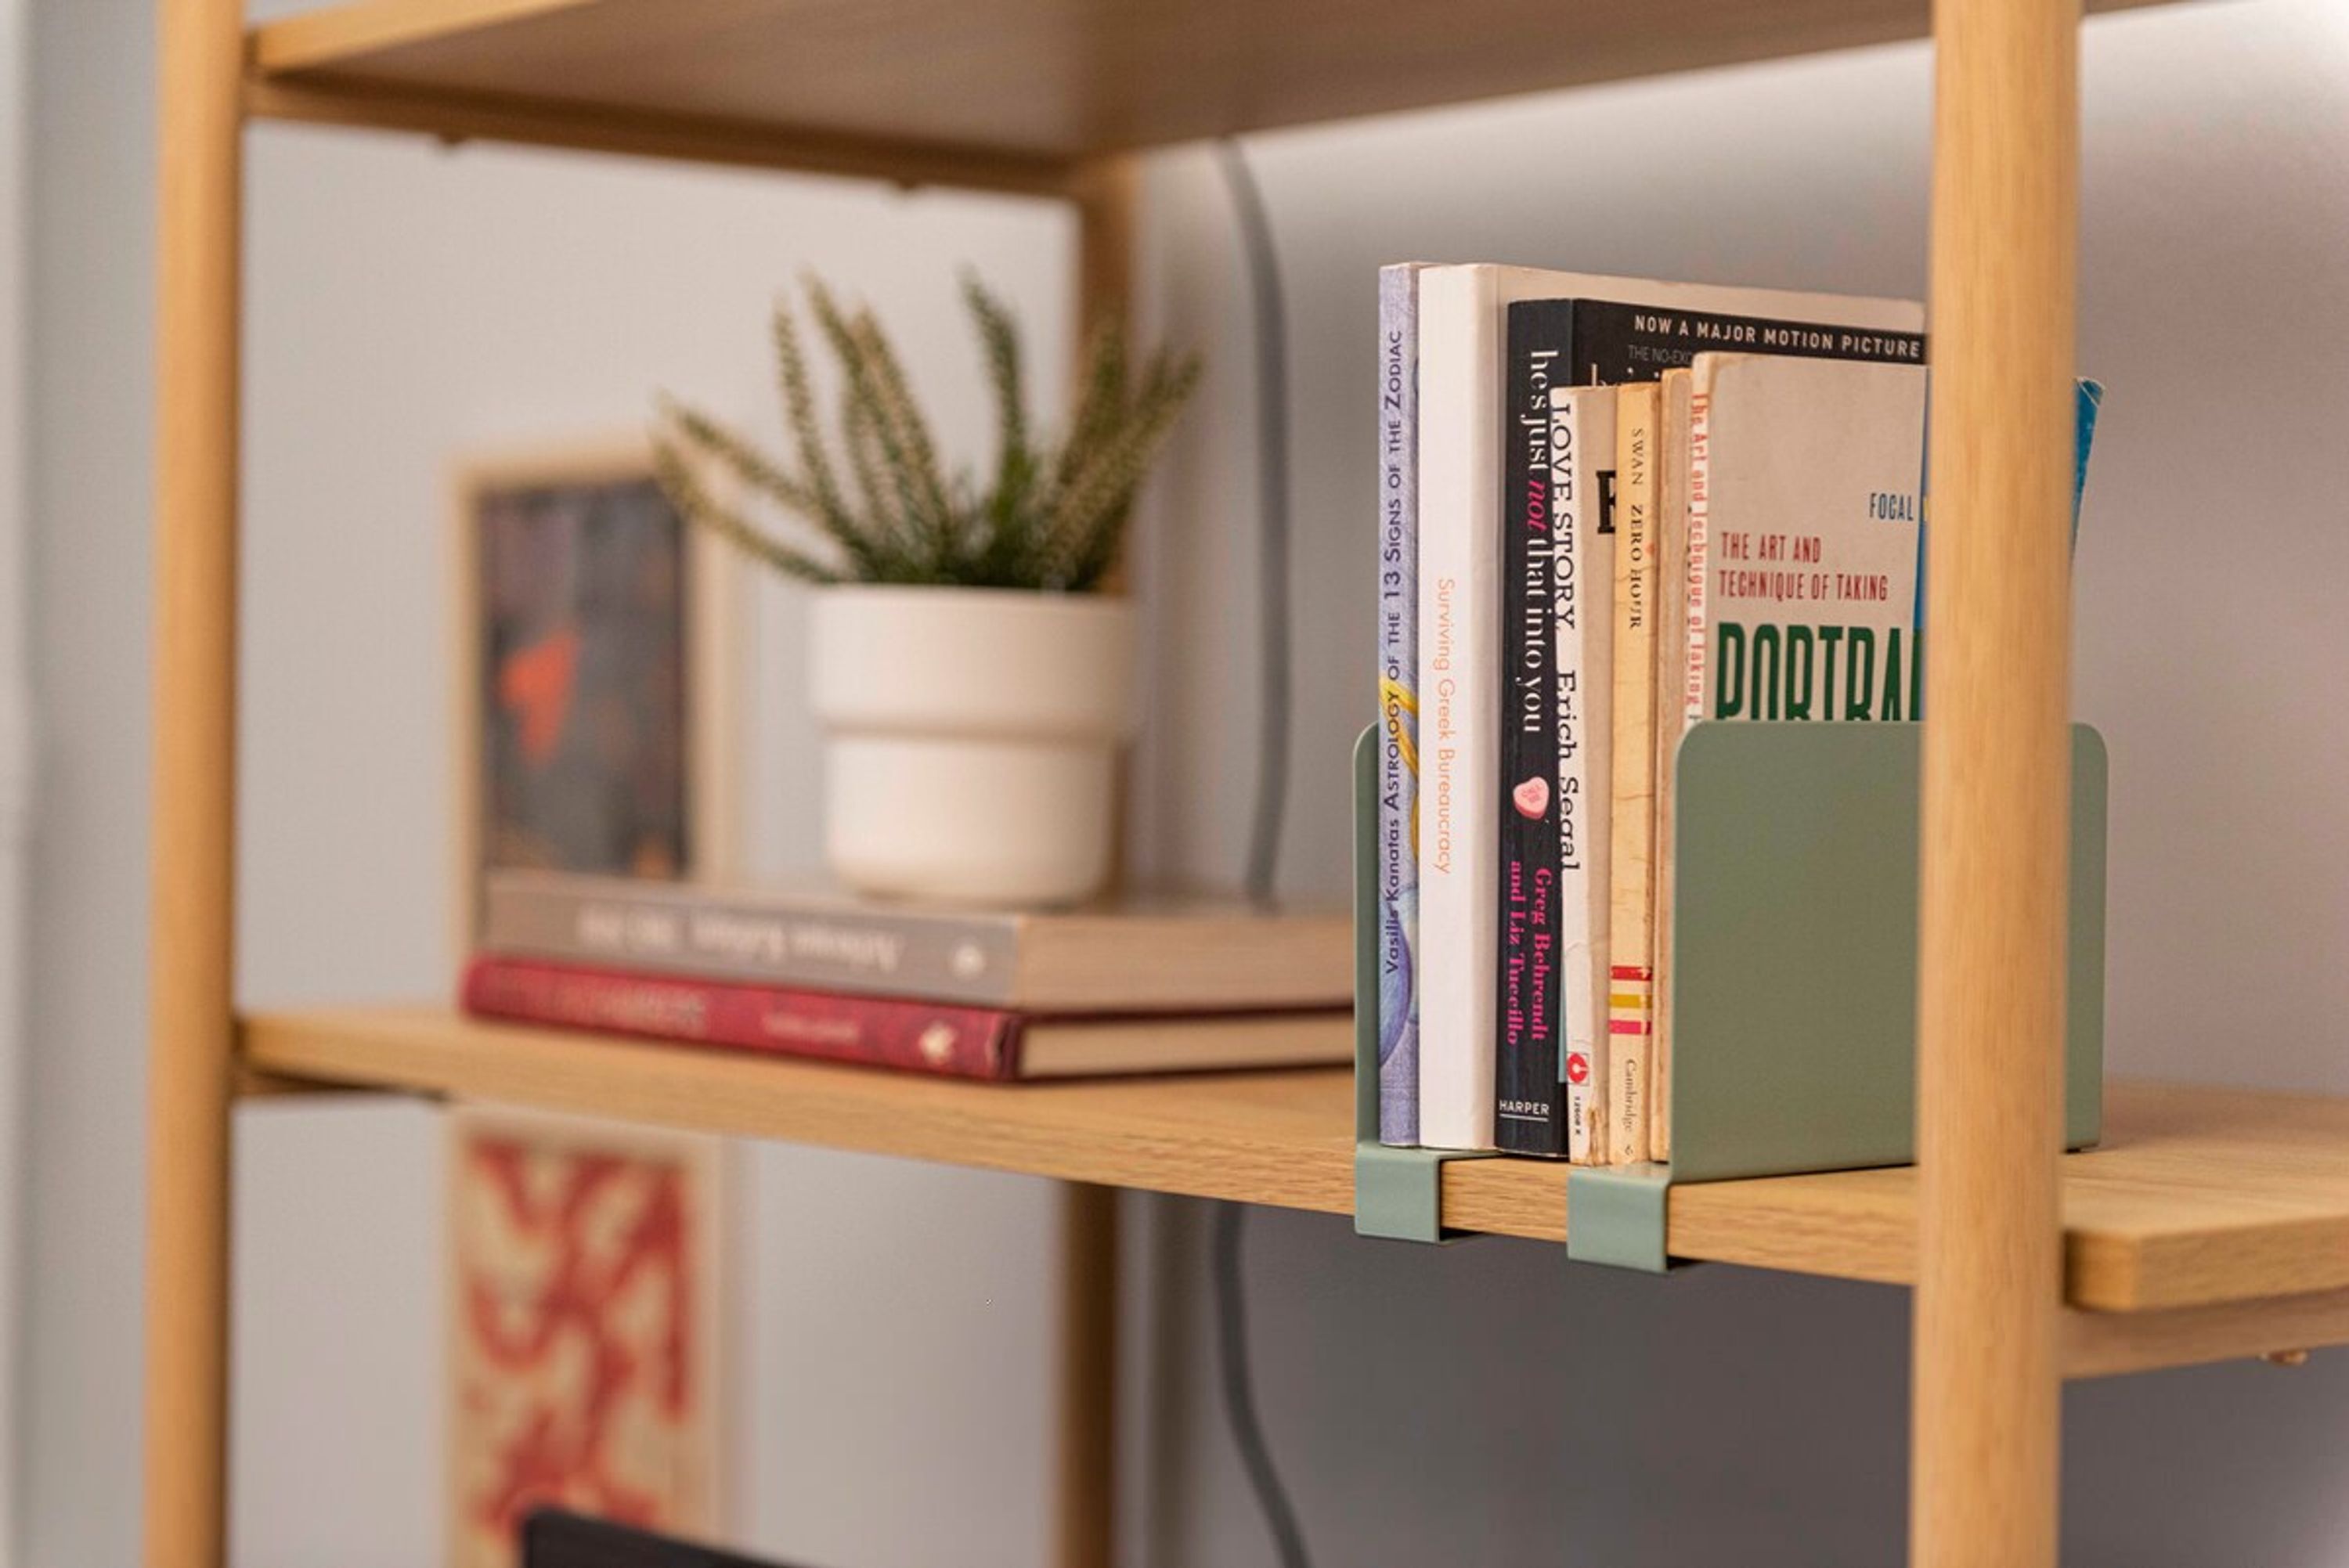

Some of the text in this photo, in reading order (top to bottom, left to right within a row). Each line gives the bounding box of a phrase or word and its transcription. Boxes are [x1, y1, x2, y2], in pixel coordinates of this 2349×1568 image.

[1629, 344, 1650, 361] THE
[1635, 315, 1921, 358] NOW A MAJOR MOTION PICTURE
[1387, 421, 1402, 452] THE
[1521, 414, 1549, 470] just
[1528, 481, 1547, 532] not
[1629, 428, 1644, 629] SWAN ZERO HOUR
[1870, 493, 1914, 521] FOCAL
[1527, 539, 1553, 597] that
[1722, 532, 1822, 564] THE ART AND
[1384, 571, 1401, 598] 13
[1719, 570, 1889, 602] TECHNIQUE OF TAKING
[1525, 609, 1552, 669] into
[1550, 404, 1580, 870] LOVE STORY Erich Segal
[1433, 579, 1456, 874] Surviving Greek Bureaucracy
[1516, 676, 1542, 733] you
[1384, 691, 1400, 811] ASTROLOGY
[1386, 820, 1400, 901] Kanatas
[1386, 910, 1400, 974] Vasilis
[1507, 861, 1527, 1045] and Liz Tuccillo
[1531, 868, 1553, 1040] Greg Behrendt
[1499, 1100, 1550, 1116] HARPER
[1622, 1058, 1637, 1132] Cambridge
